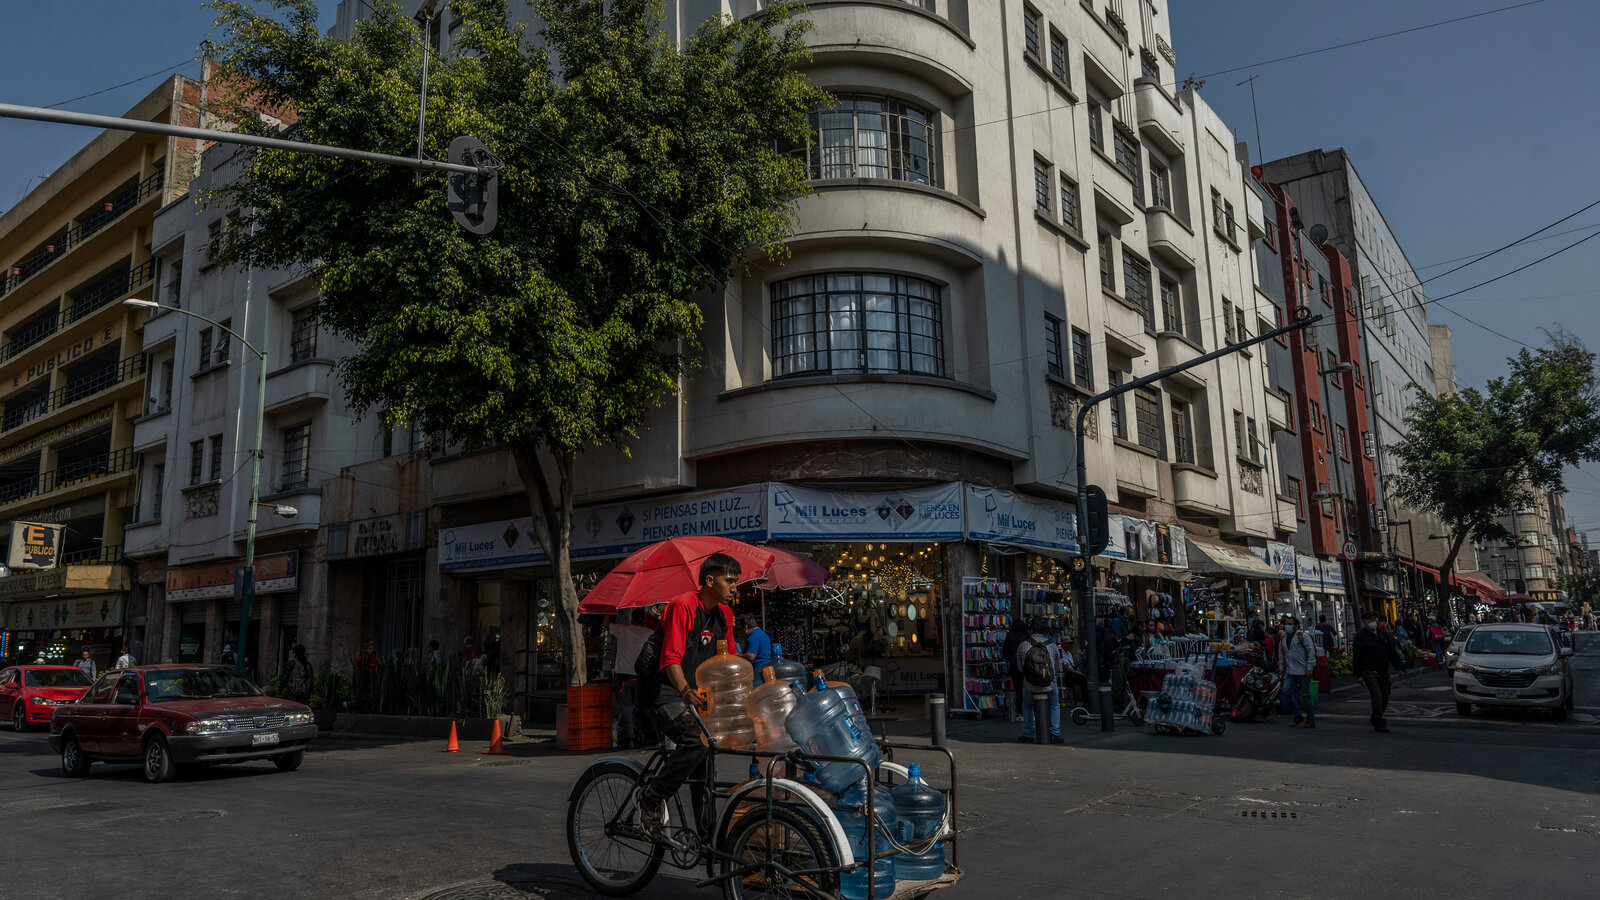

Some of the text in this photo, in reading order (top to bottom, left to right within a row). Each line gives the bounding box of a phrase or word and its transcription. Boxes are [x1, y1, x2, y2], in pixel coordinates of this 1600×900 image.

[27, 336, 93, 382] PUBLICO
[643, 497, 750, 522] SI PIENSAS EN LUZ...
[795, 505, 867, 517] Mil Luces
[948, 504, 960, 512] EN
[934, 511, 960, 520] LUCES
[643, 514, 762, 540] PIENSA EN MIL LUCES
[997, 513, 1036, 531] Mil Luces
[27, 525, 45, 546] E
[24, 545, 54, 556] PUBLICO
[455, 540, 495, 553] Mil Luces
[1345, 544, 1356, 554] 40
[901, 671, 917, 681] Mil
